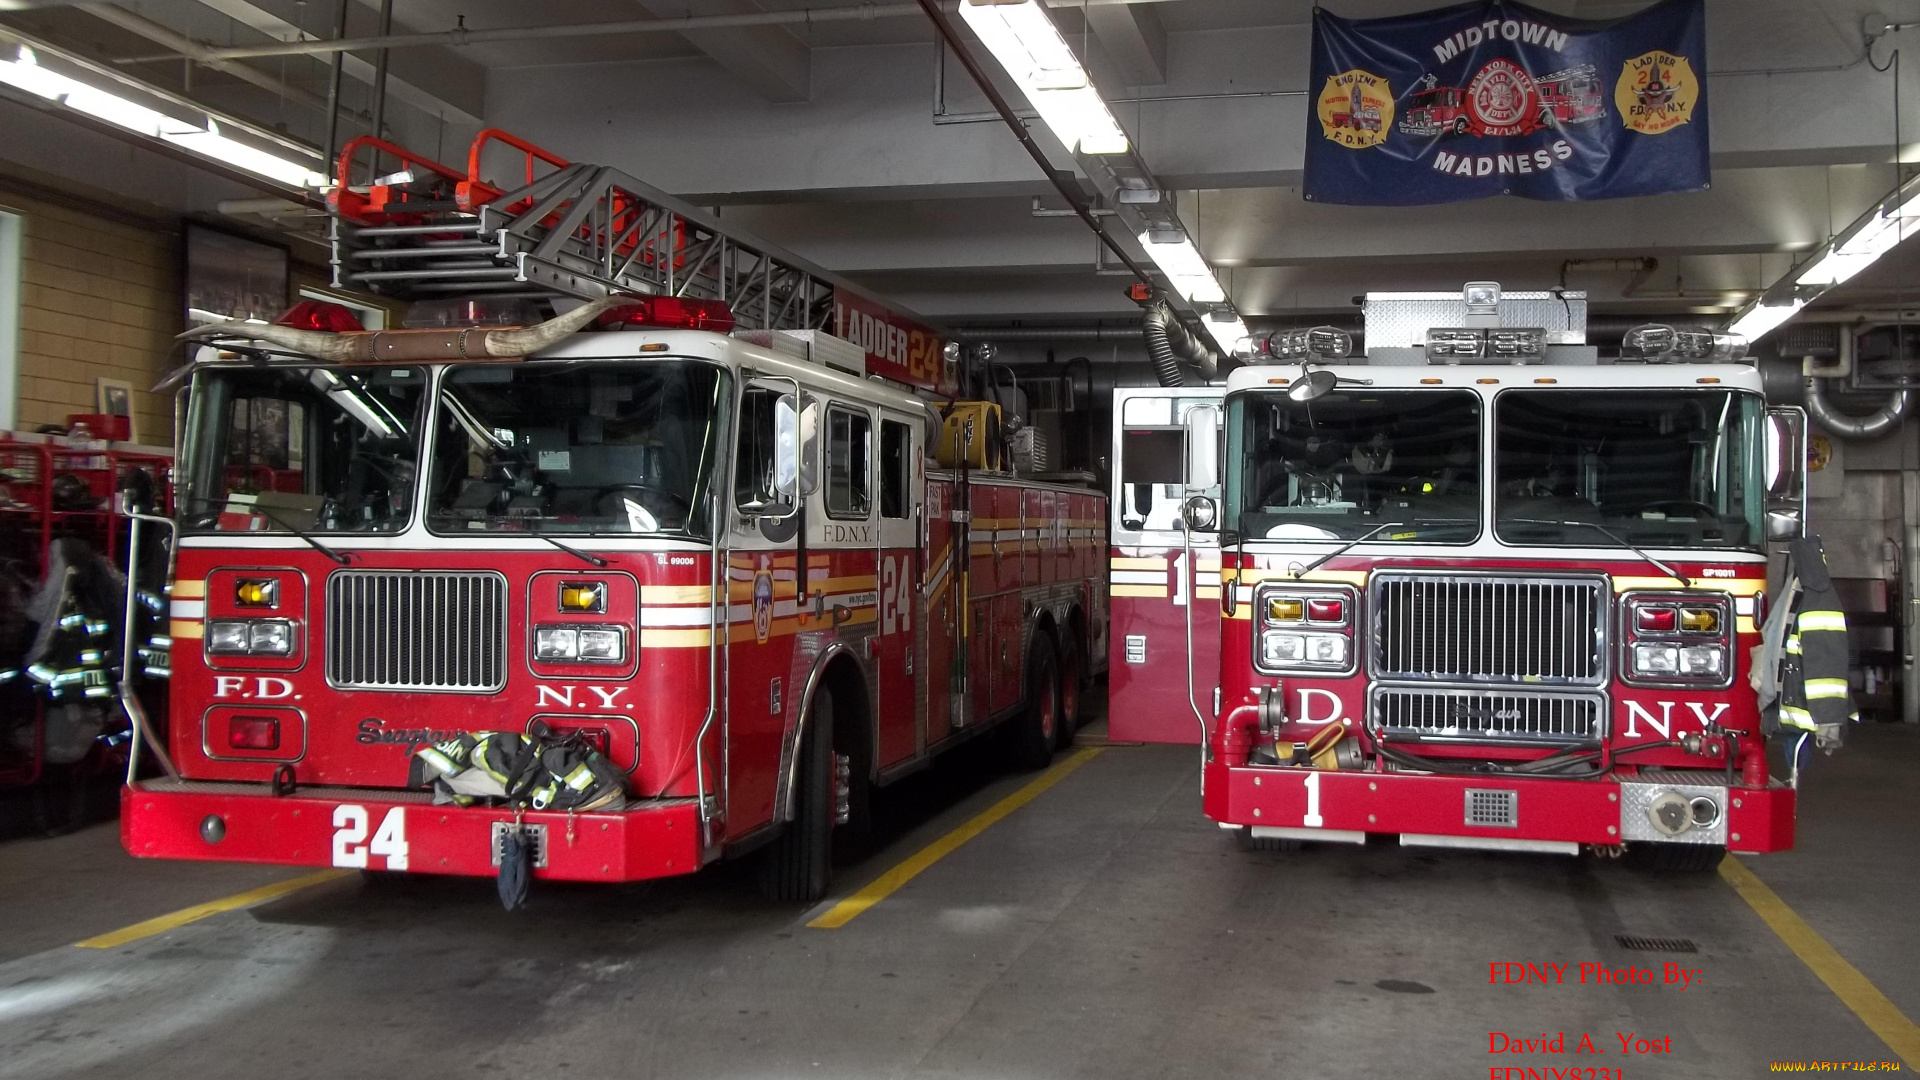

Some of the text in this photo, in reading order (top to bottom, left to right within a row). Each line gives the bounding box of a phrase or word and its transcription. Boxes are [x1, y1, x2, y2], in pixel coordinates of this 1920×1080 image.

[1433, 19, 1568, 64] MIDTOWN
[1335, 74, 1377, 87] ENGINE
[1468, 61, 1533, 95] NEW YORK CITY
[1490, 75, 1511, 84] FIRE
[1633, 56, 1676, 70] LADDER
[1661, 116, 1680, 128] MORE
[1433, 140, 1572, 176] MADNESS
[837, 302, 940, 383] LADDER 24
[823, 525, 872, 543] F.D.N.Y.
[883, 555, 910, 635] 24
[1173, 552, 1187, 605] 1
[213, 676, 635, 709] F.D. N.Y.
[1304, 772, 1323, 827] 1
[332, 804, 408, 871] 24
